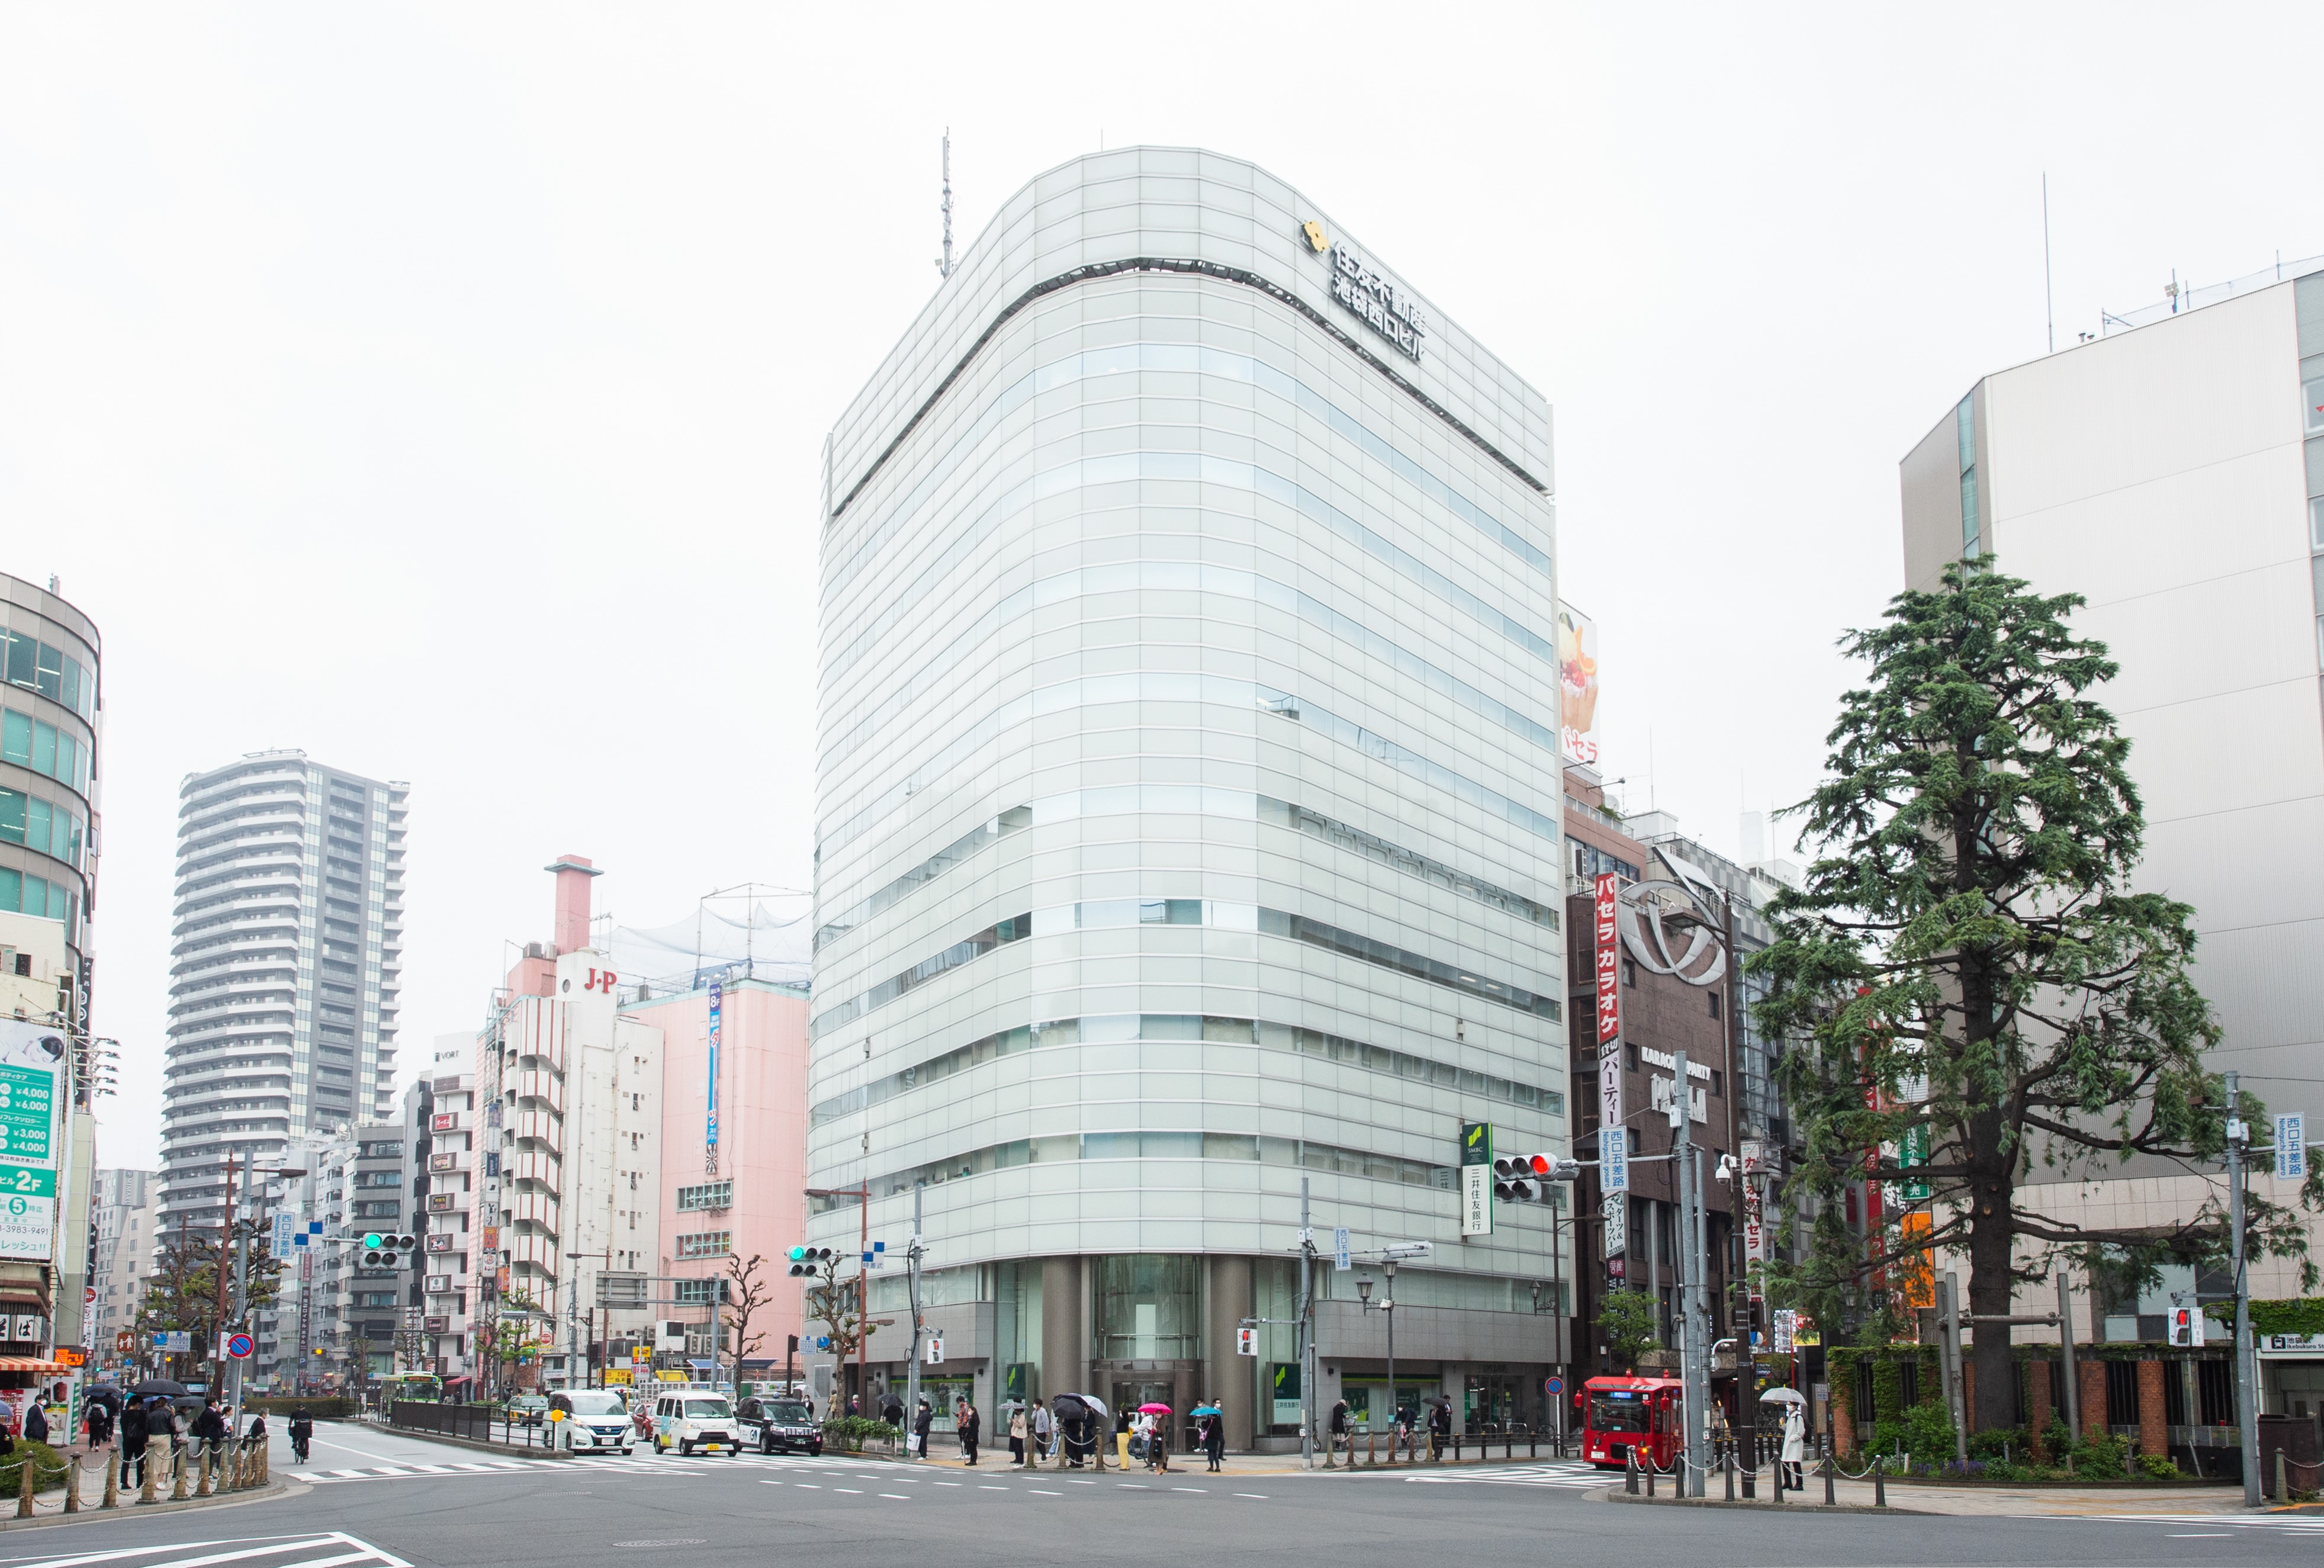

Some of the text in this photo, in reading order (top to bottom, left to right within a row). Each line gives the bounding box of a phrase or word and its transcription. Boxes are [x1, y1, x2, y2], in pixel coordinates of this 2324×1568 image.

[1333, 241, 1426, 336] 住友不動産
[1333, 271, 1425, 361] 池袋西口ビル
[1597, 877, 1614, 941] パセラ
[711, 995, 719, 1007] 8F
[1599, 949, 1618, 1033] カラオケ
[441, 1050, 459, 1059] VORT
[1641, 1046, 1711, 1081] KARAO PARTY
[15, 1100, 48, 1111] ¥6,000
[16, 1087, 49, 1099] ¥4,000
[12, 1141, 46, 1152] ¥4,000
[13, 1128, 46, 1140] ¥3,000
[2278, 1118, 2286, 1151] Nishiguchi
[2287, 1117, 2302, 1175] 西口五差路
[1611, 1131, 1624, 1187] 西口五差路
[1471, 1168, 1481, 1230] 三井住友銀行
[279, 1214, 291, 1256] 西口五差路
[1606, 1203, 1616, 1248] スポーツバー
